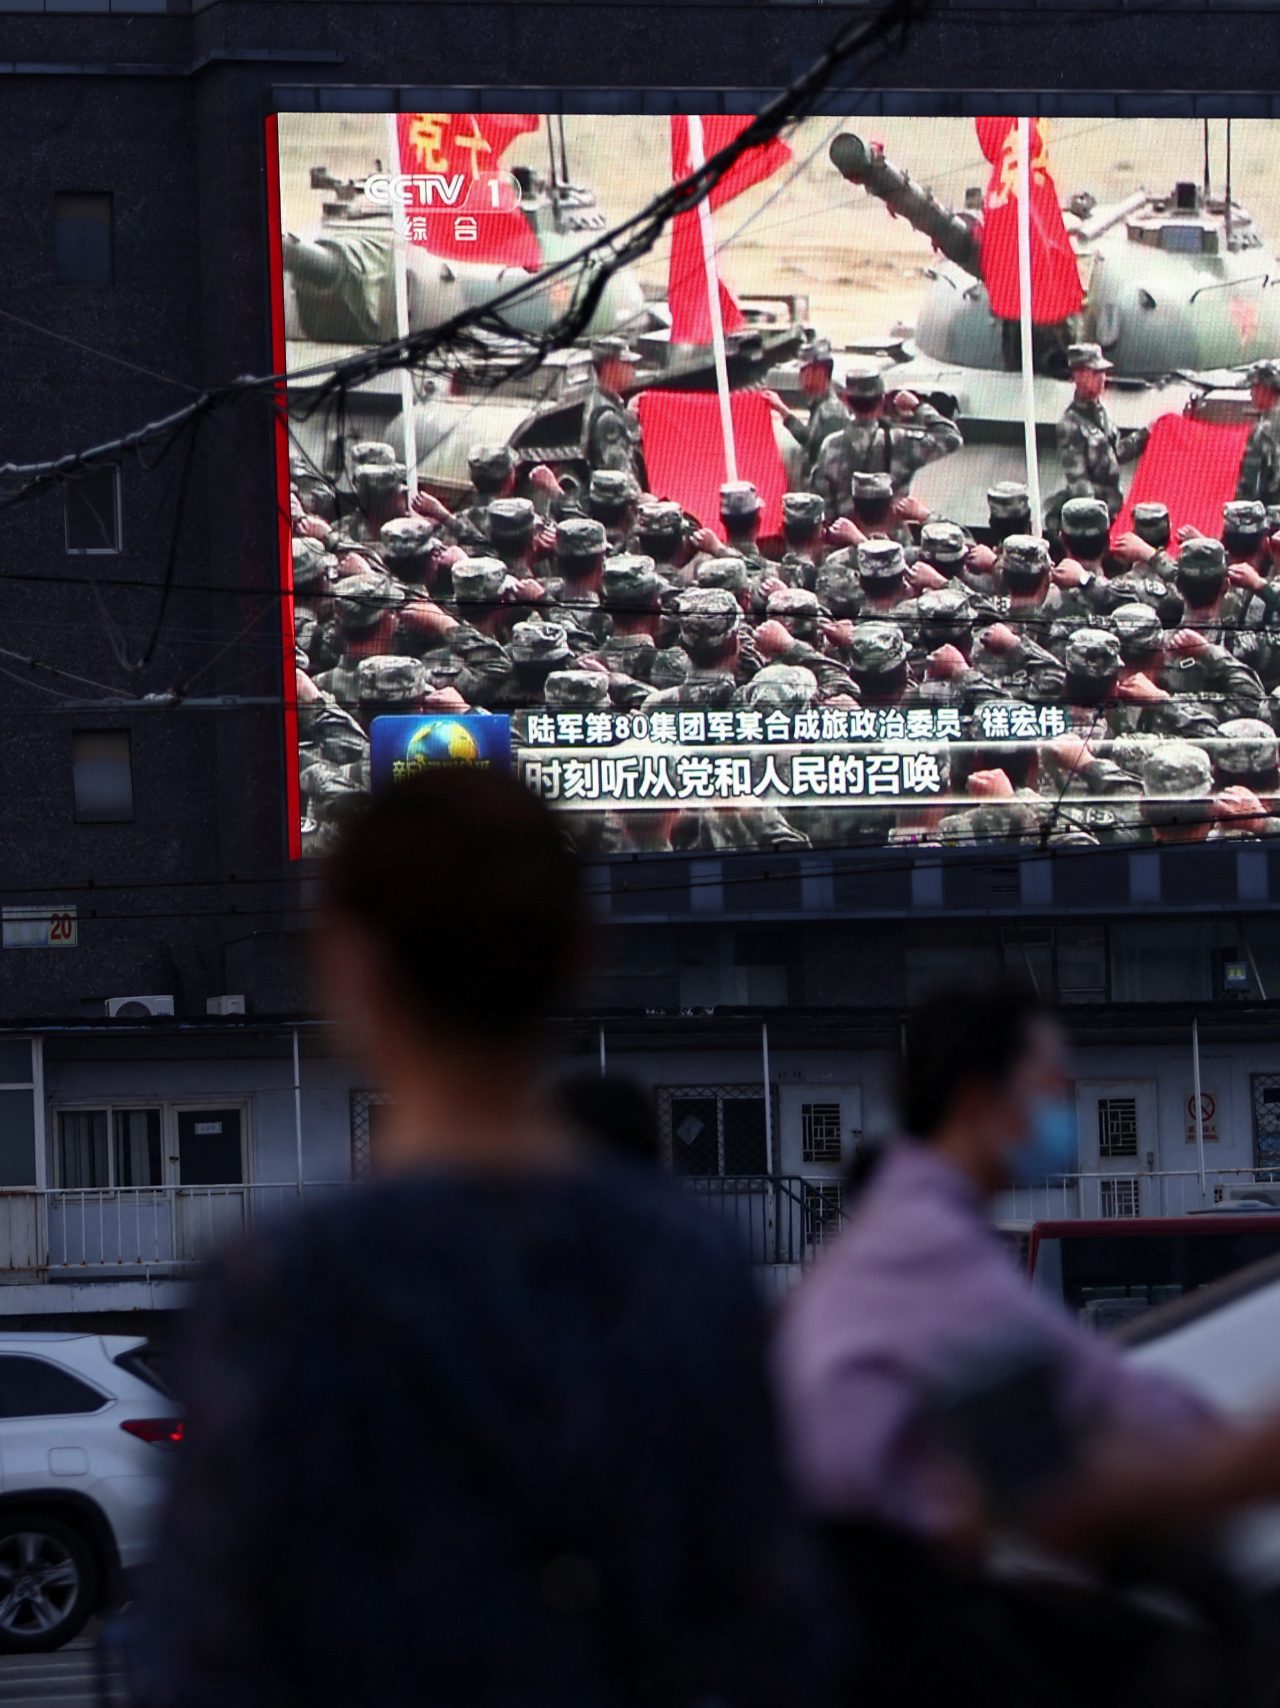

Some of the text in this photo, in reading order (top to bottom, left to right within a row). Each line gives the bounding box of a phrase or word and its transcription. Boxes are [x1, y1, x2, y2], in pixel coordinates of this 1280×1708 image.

[364, 173, 500, 208] CCTV 1
[527, 709, 962, 743] 陆军第80集团军某合成旅政治委员
[525, 754, 940, 799] 时刻听从党和人民的召唤
[51, 912, 72, 940] 20
